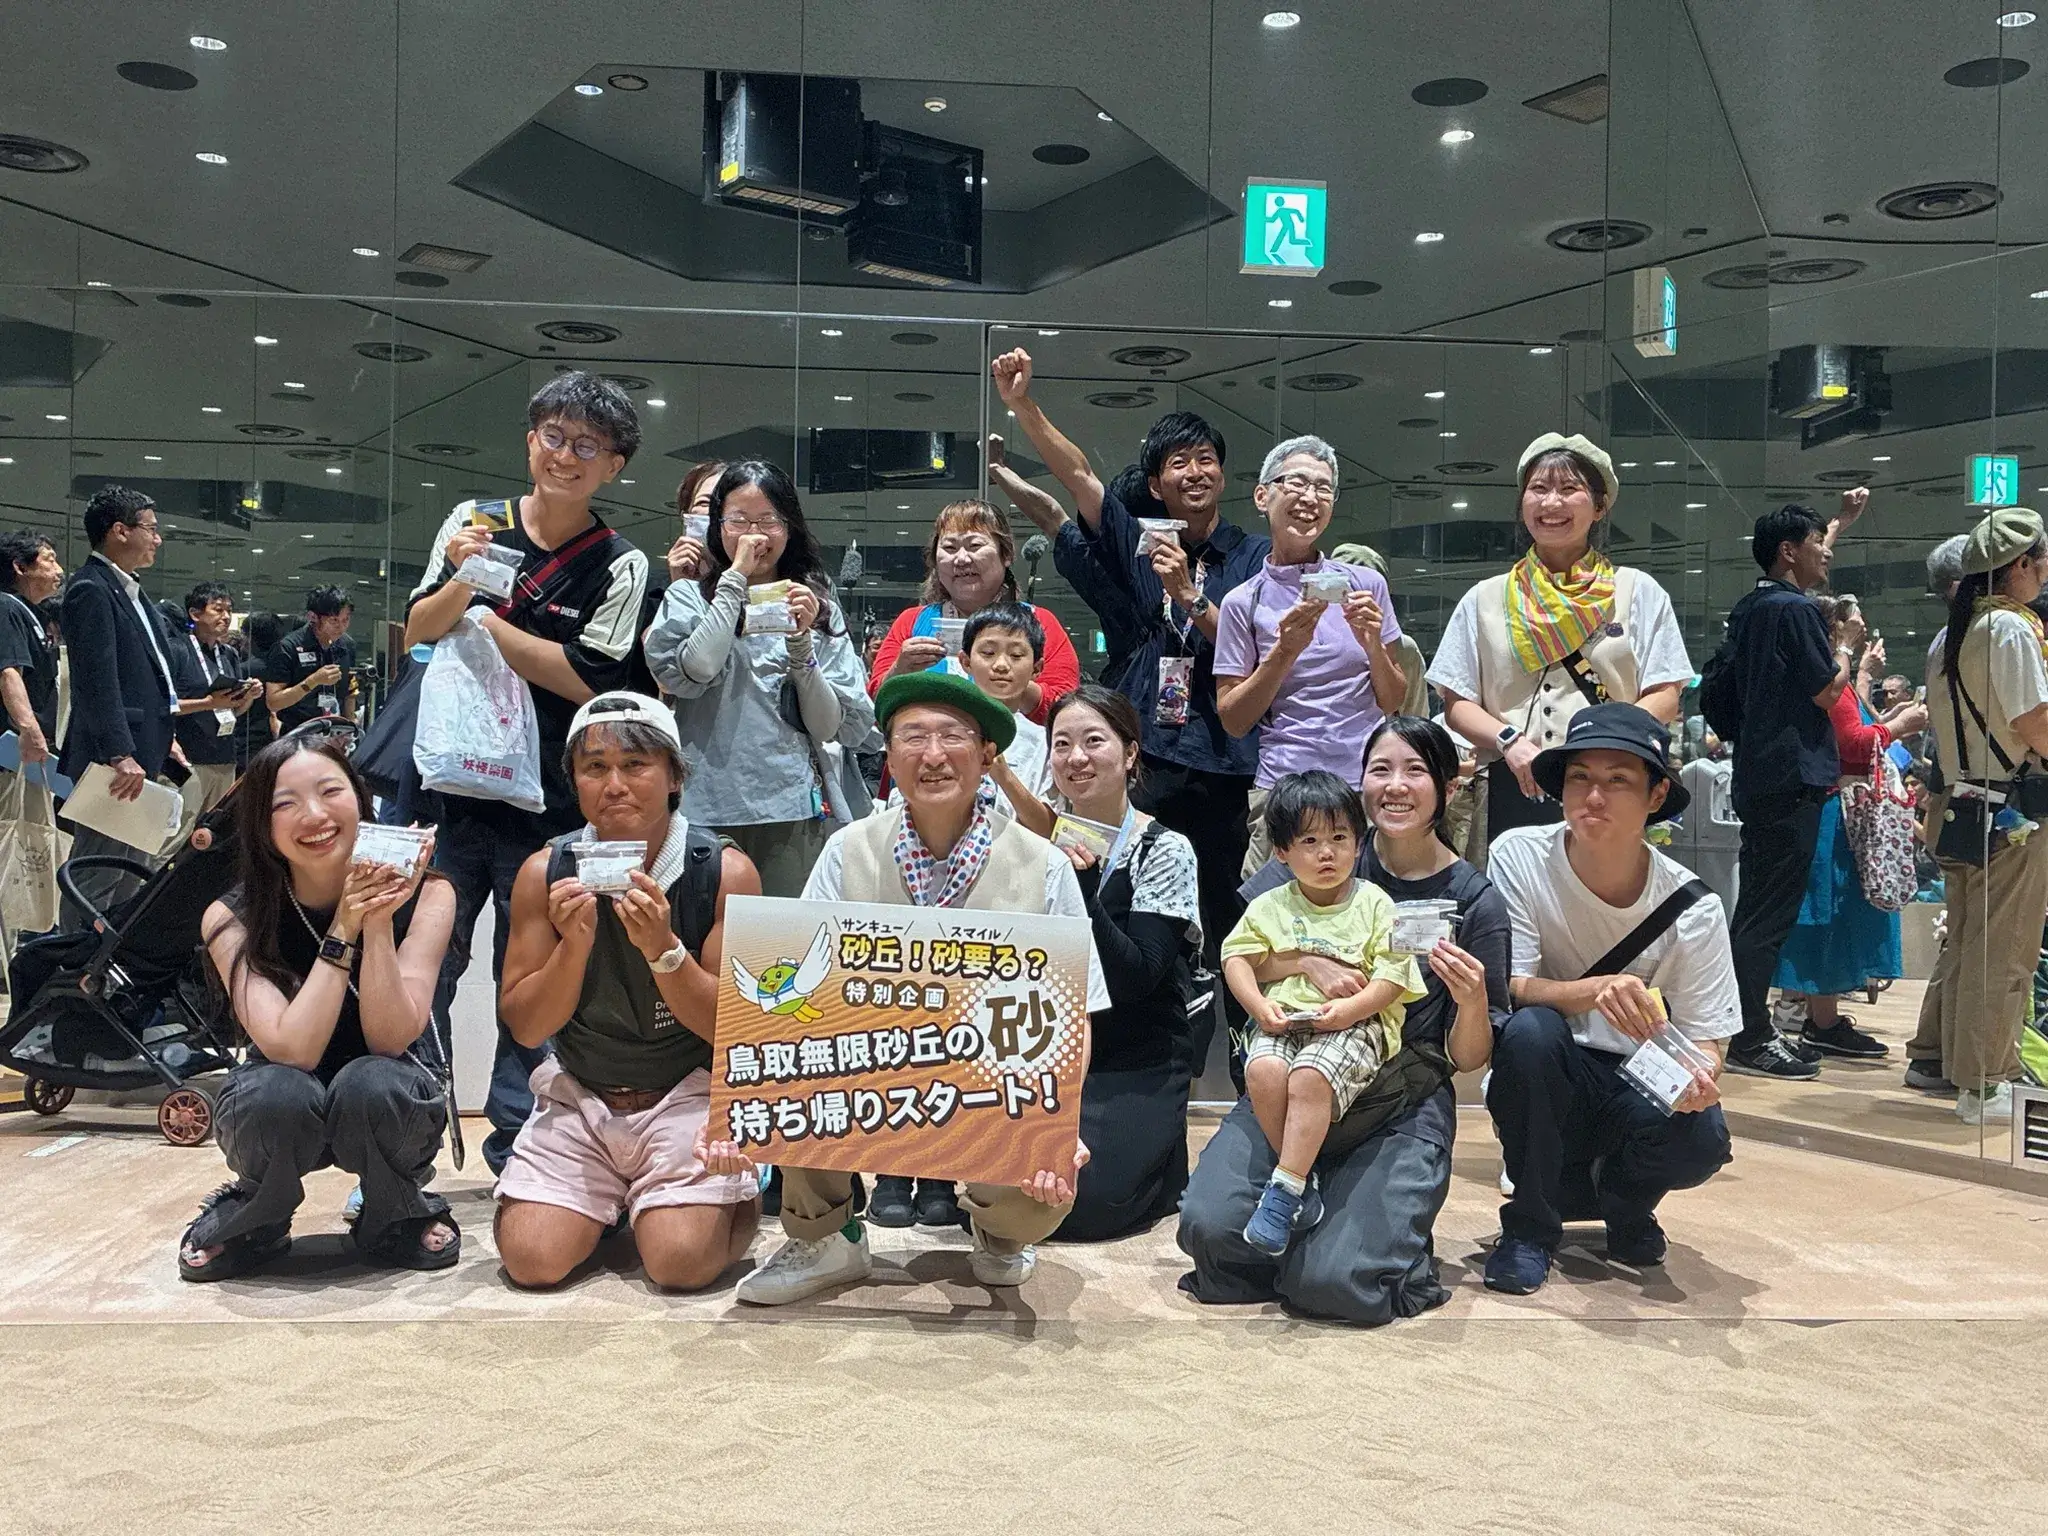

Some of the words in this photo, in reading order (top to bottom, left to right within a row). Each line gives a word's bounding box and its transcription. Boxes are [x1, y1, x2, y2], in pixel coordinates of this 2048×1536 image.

[841, 918, 903, 933] サンキュー
[951, 926, 1001, 941] スマイル
[845, 980, 947, 1010] 特別企画
[729, 1073, 1059, 1144] 持ち帰りスタート！
